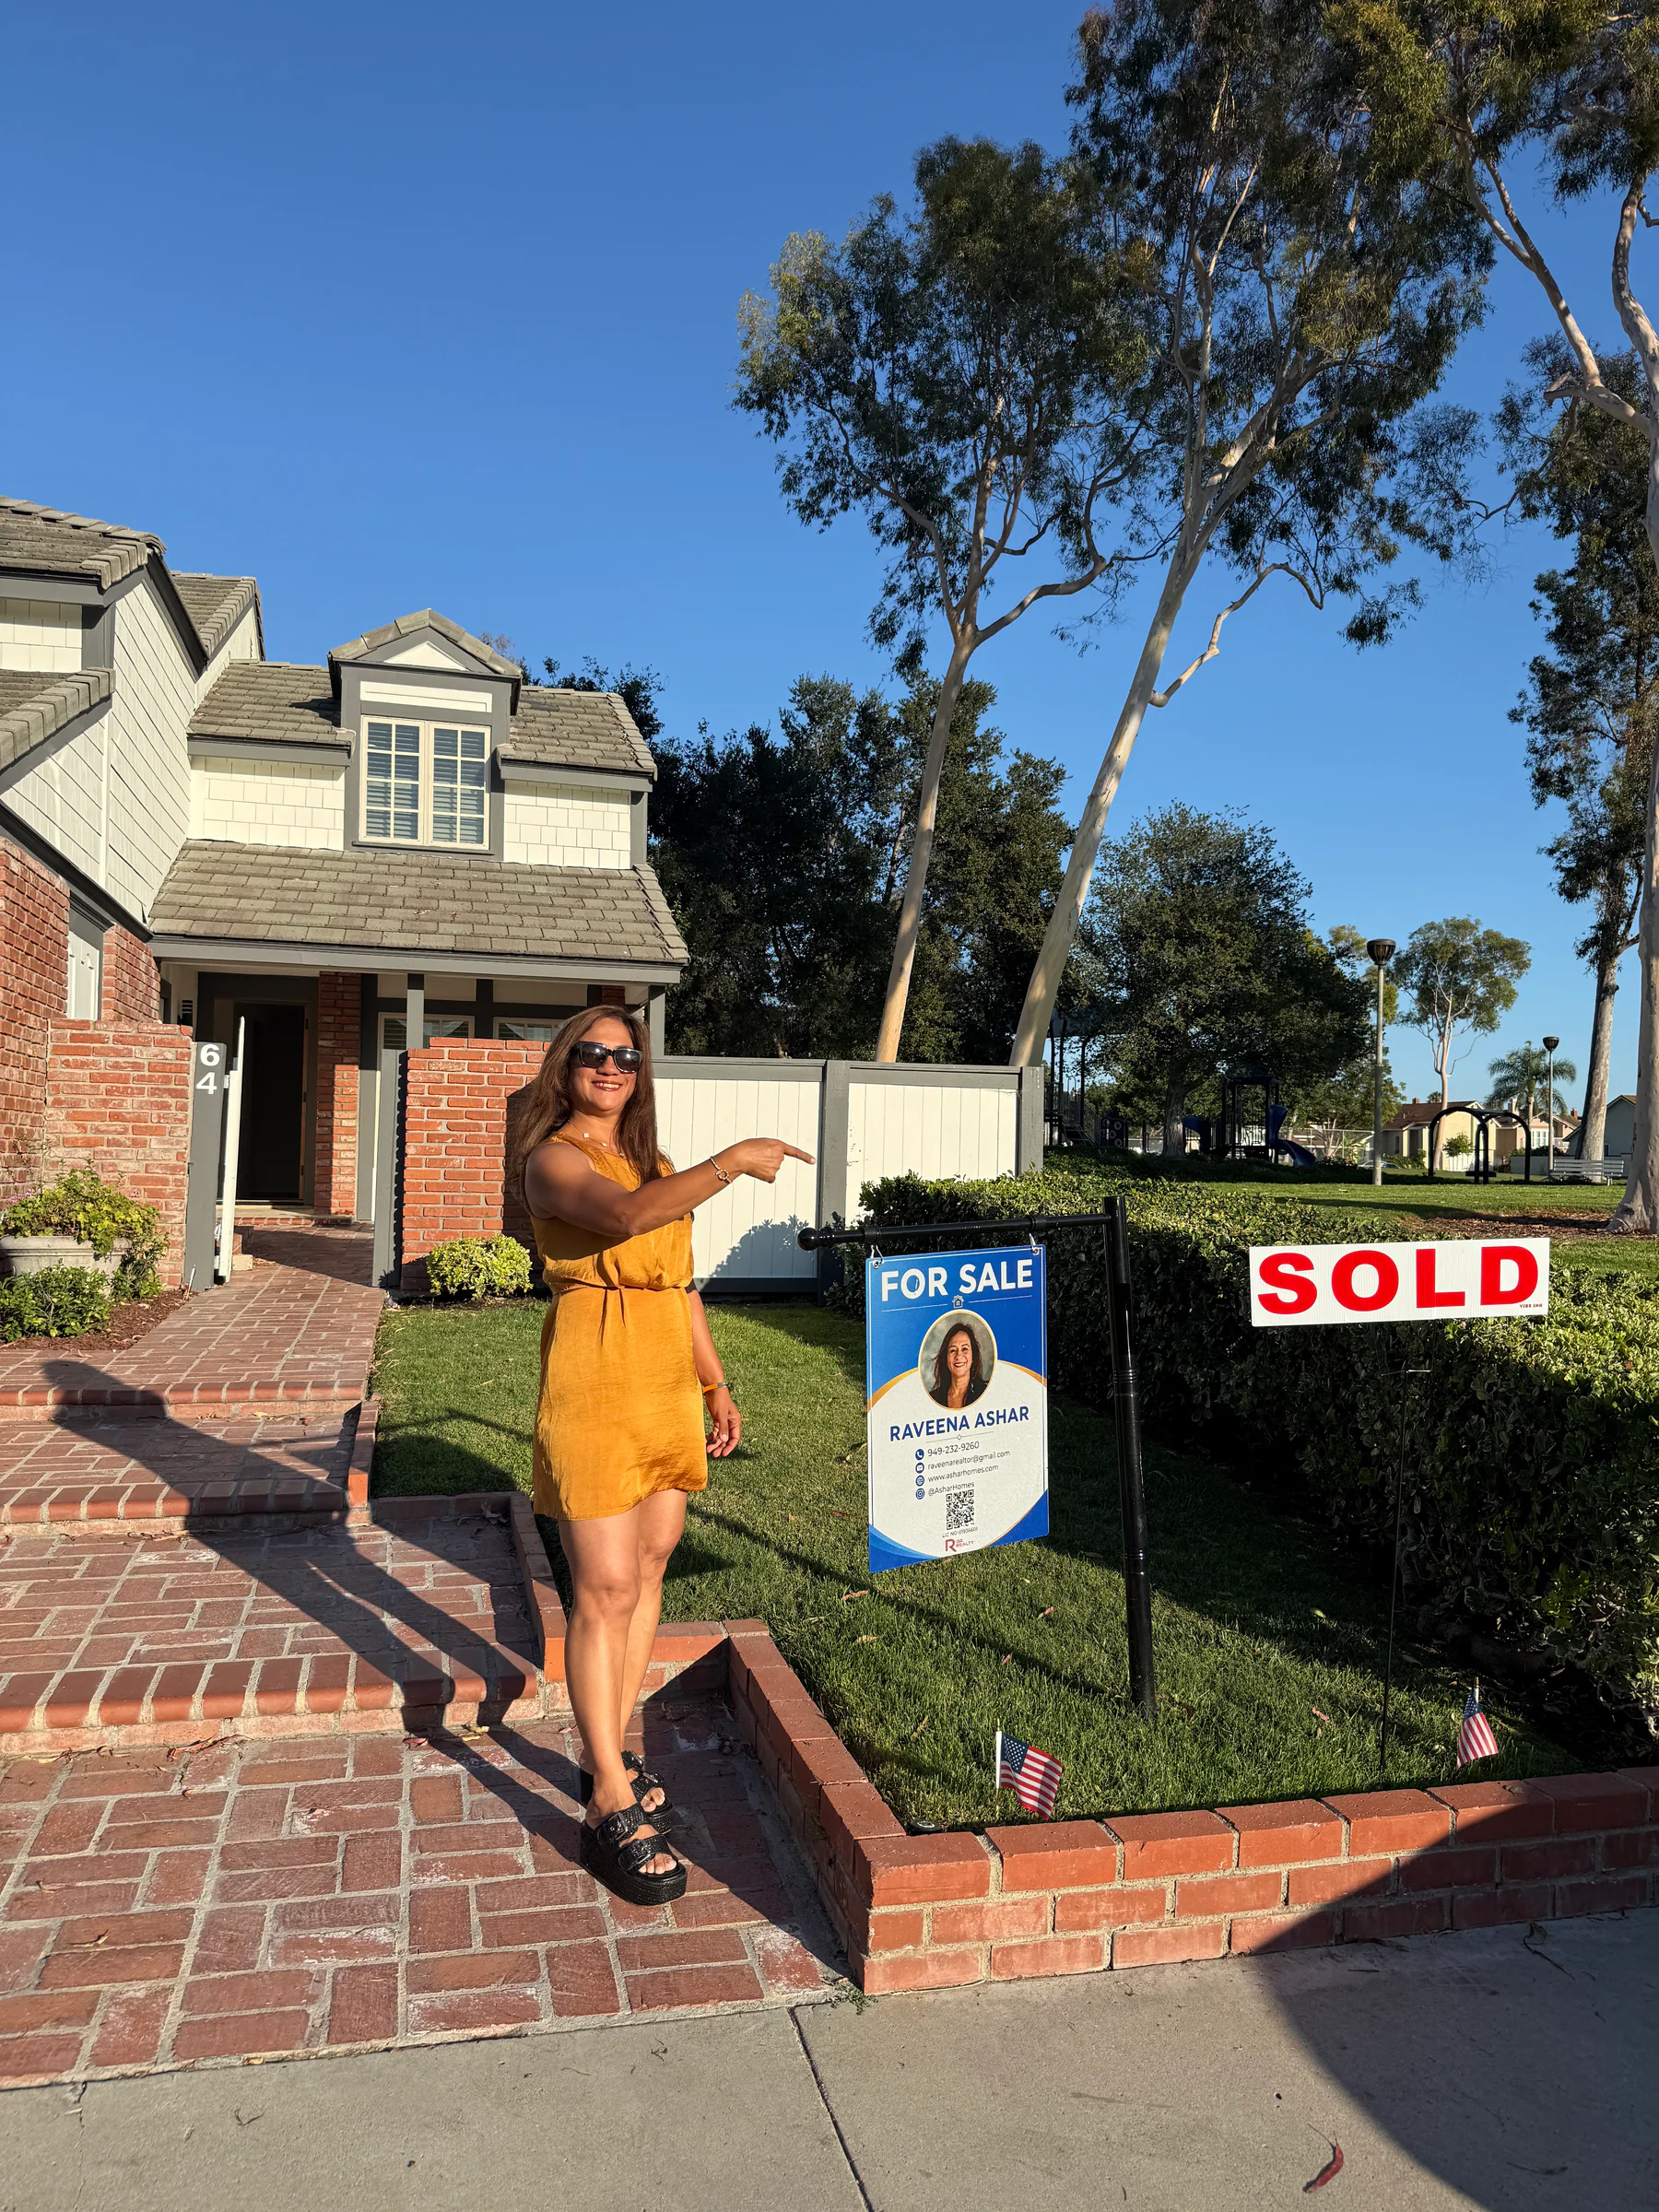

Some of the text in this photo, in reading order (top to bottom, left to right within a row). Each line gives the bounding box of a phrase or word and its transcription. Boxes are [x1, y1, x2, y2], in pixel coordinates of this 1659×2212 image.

[881, 1259, 1033, 1301] FOR SALE
[1257, 1245, 1538, 1315] SOLD
[889, 1406, 1030, 1441] RAVEENA ASHAR
[927, 1441, 980, 1457] 949-232-9260
[927, 1450, 1011, 1470] raveenarealtor@gmail.com
[927, 1464, 999, 1483] www.asharhomes.com
[928, 1481, 975, 1496] @AsharHomes
